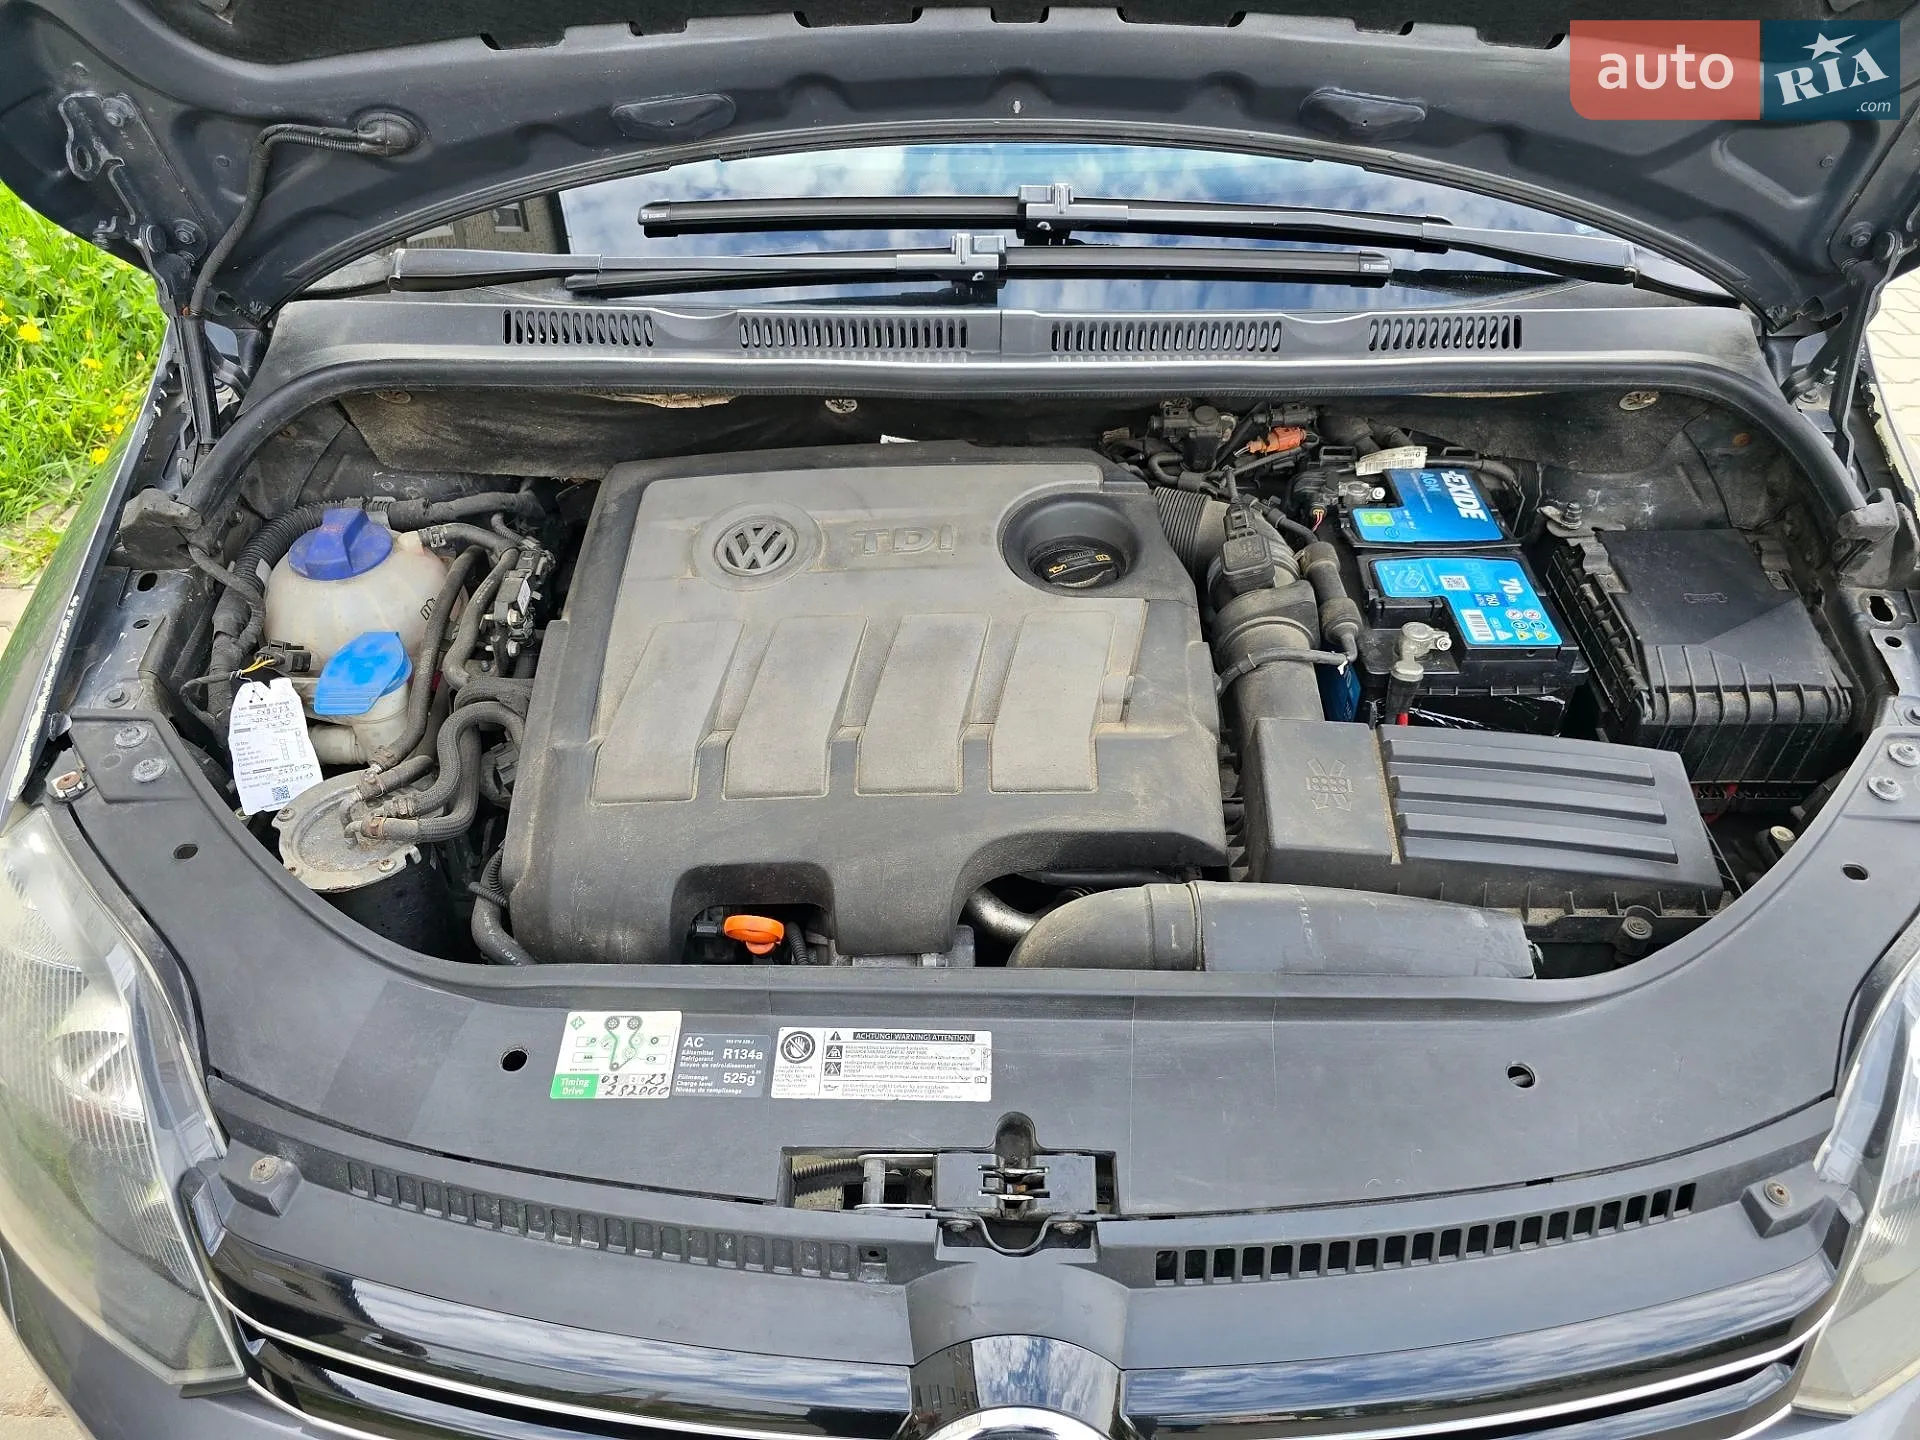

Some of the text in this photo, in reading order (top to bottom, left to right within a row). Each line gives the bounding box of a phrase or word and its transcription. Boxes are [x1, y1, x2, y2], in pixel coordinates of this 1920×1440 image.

[1420, 472, 1441, 492] AGM
[1441, 471, 1488, 522] EXIDE
[853, 525, 953, 555] TDI
[1498, 579, 1524, 594] 70
[1484, 594, 1500, 606] 760
[683, 1036, 704, 1048] AC
[855, 1032, 893, 1040] ACHTUNG!
[894, 1033, 930, 1041] WARNING!
[723, 1048, 763, 1060] R134a
[561, 1077, 591, 1088] Timing
[723, 1072, 756, 1087] 525g
[562, 1087, 585, 1095] Drive
